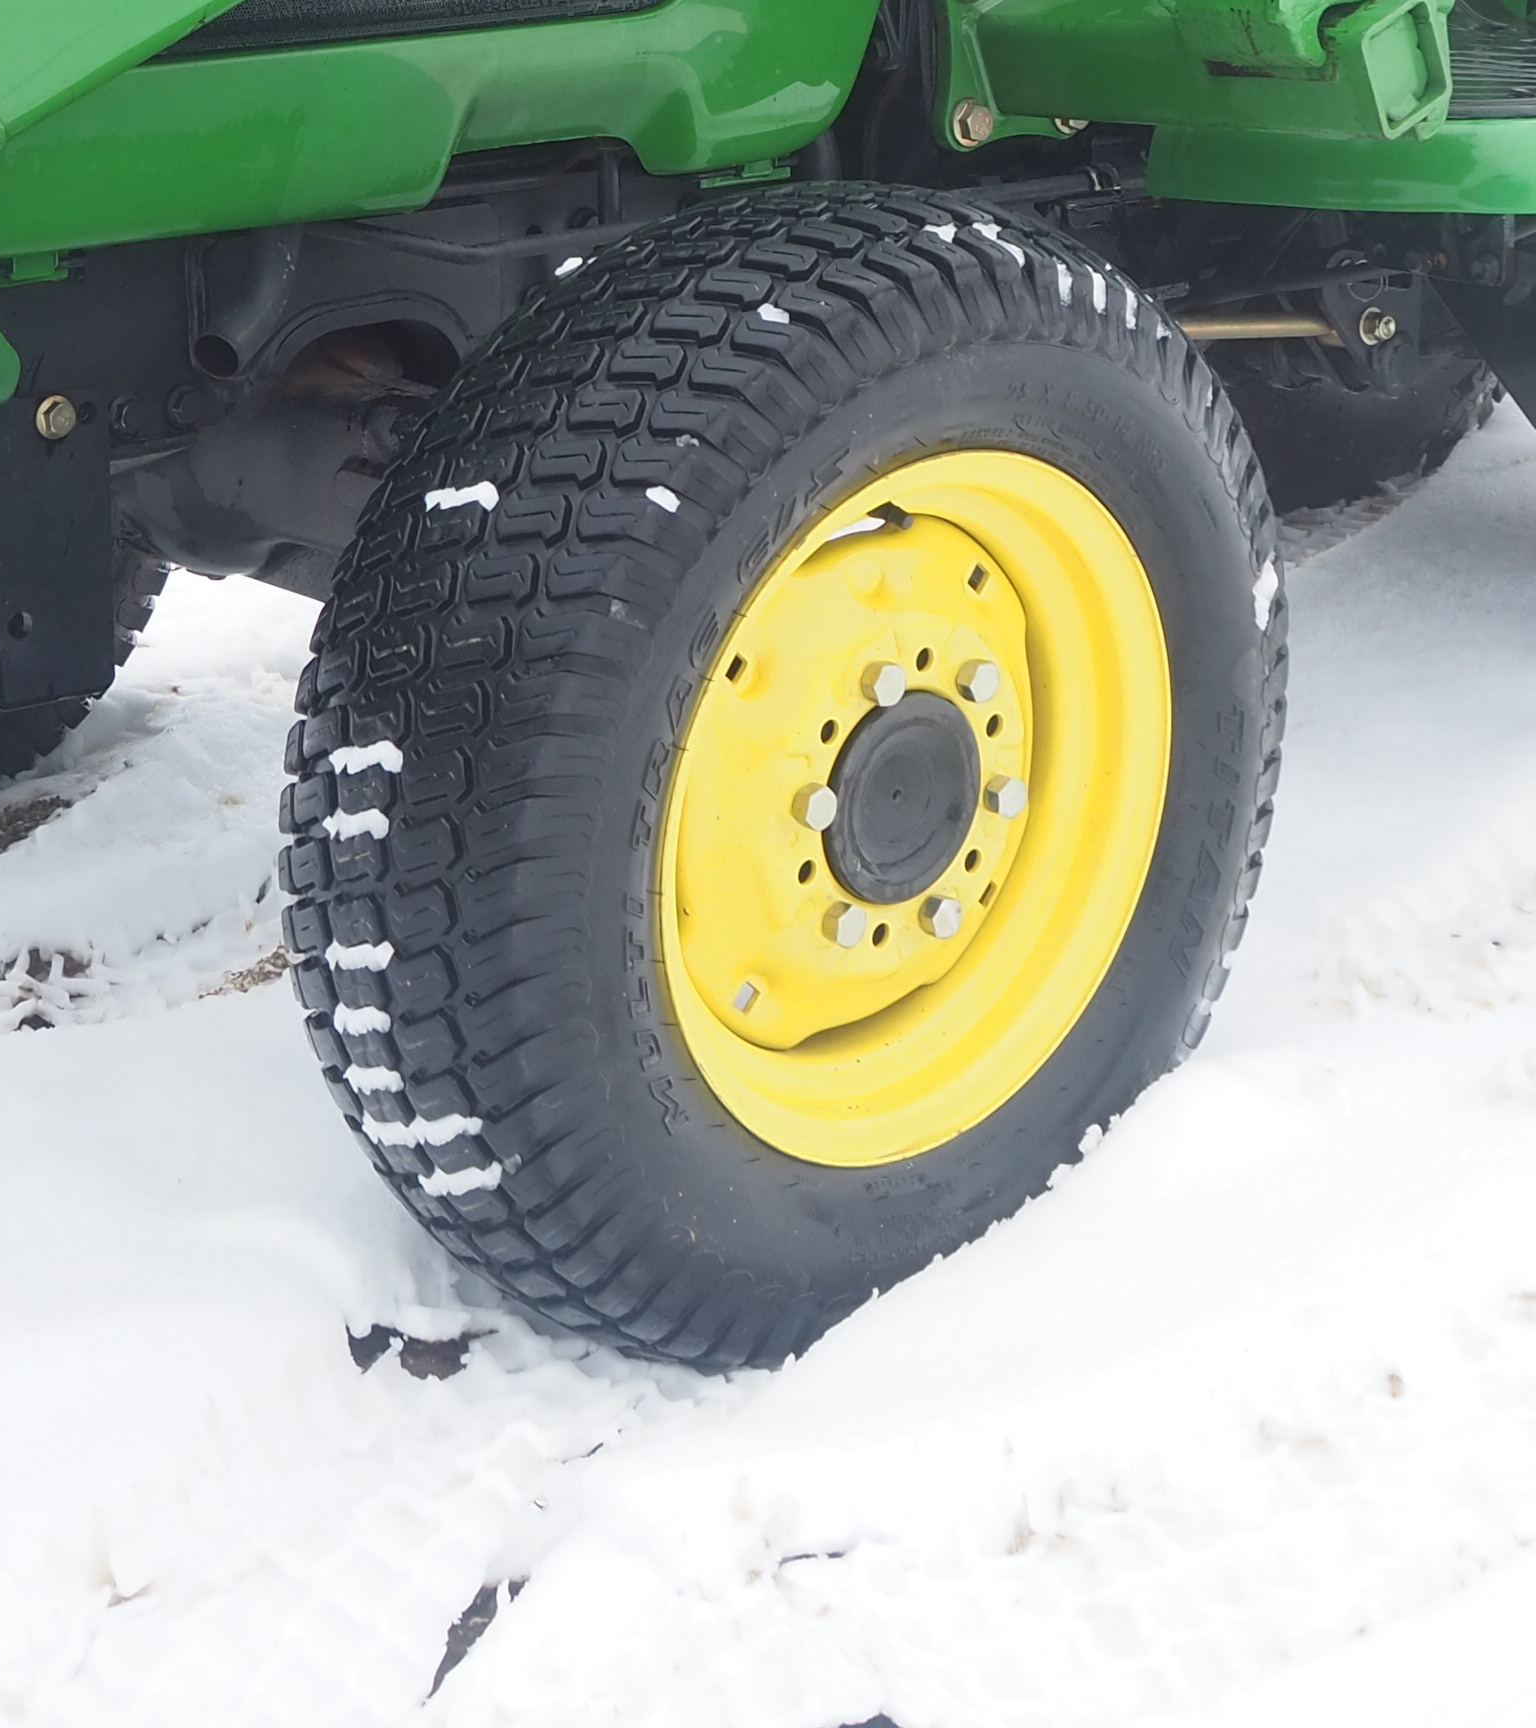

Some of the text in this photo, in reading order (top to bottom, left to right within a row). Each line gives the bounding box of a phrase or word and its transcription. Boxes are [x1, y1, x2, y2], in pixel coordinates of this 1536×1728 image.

[632, 609, 725, 852] TRAC
[1169, 704, 1245, 980] TITAN
[624, 893, 690, 1134] MULTI
